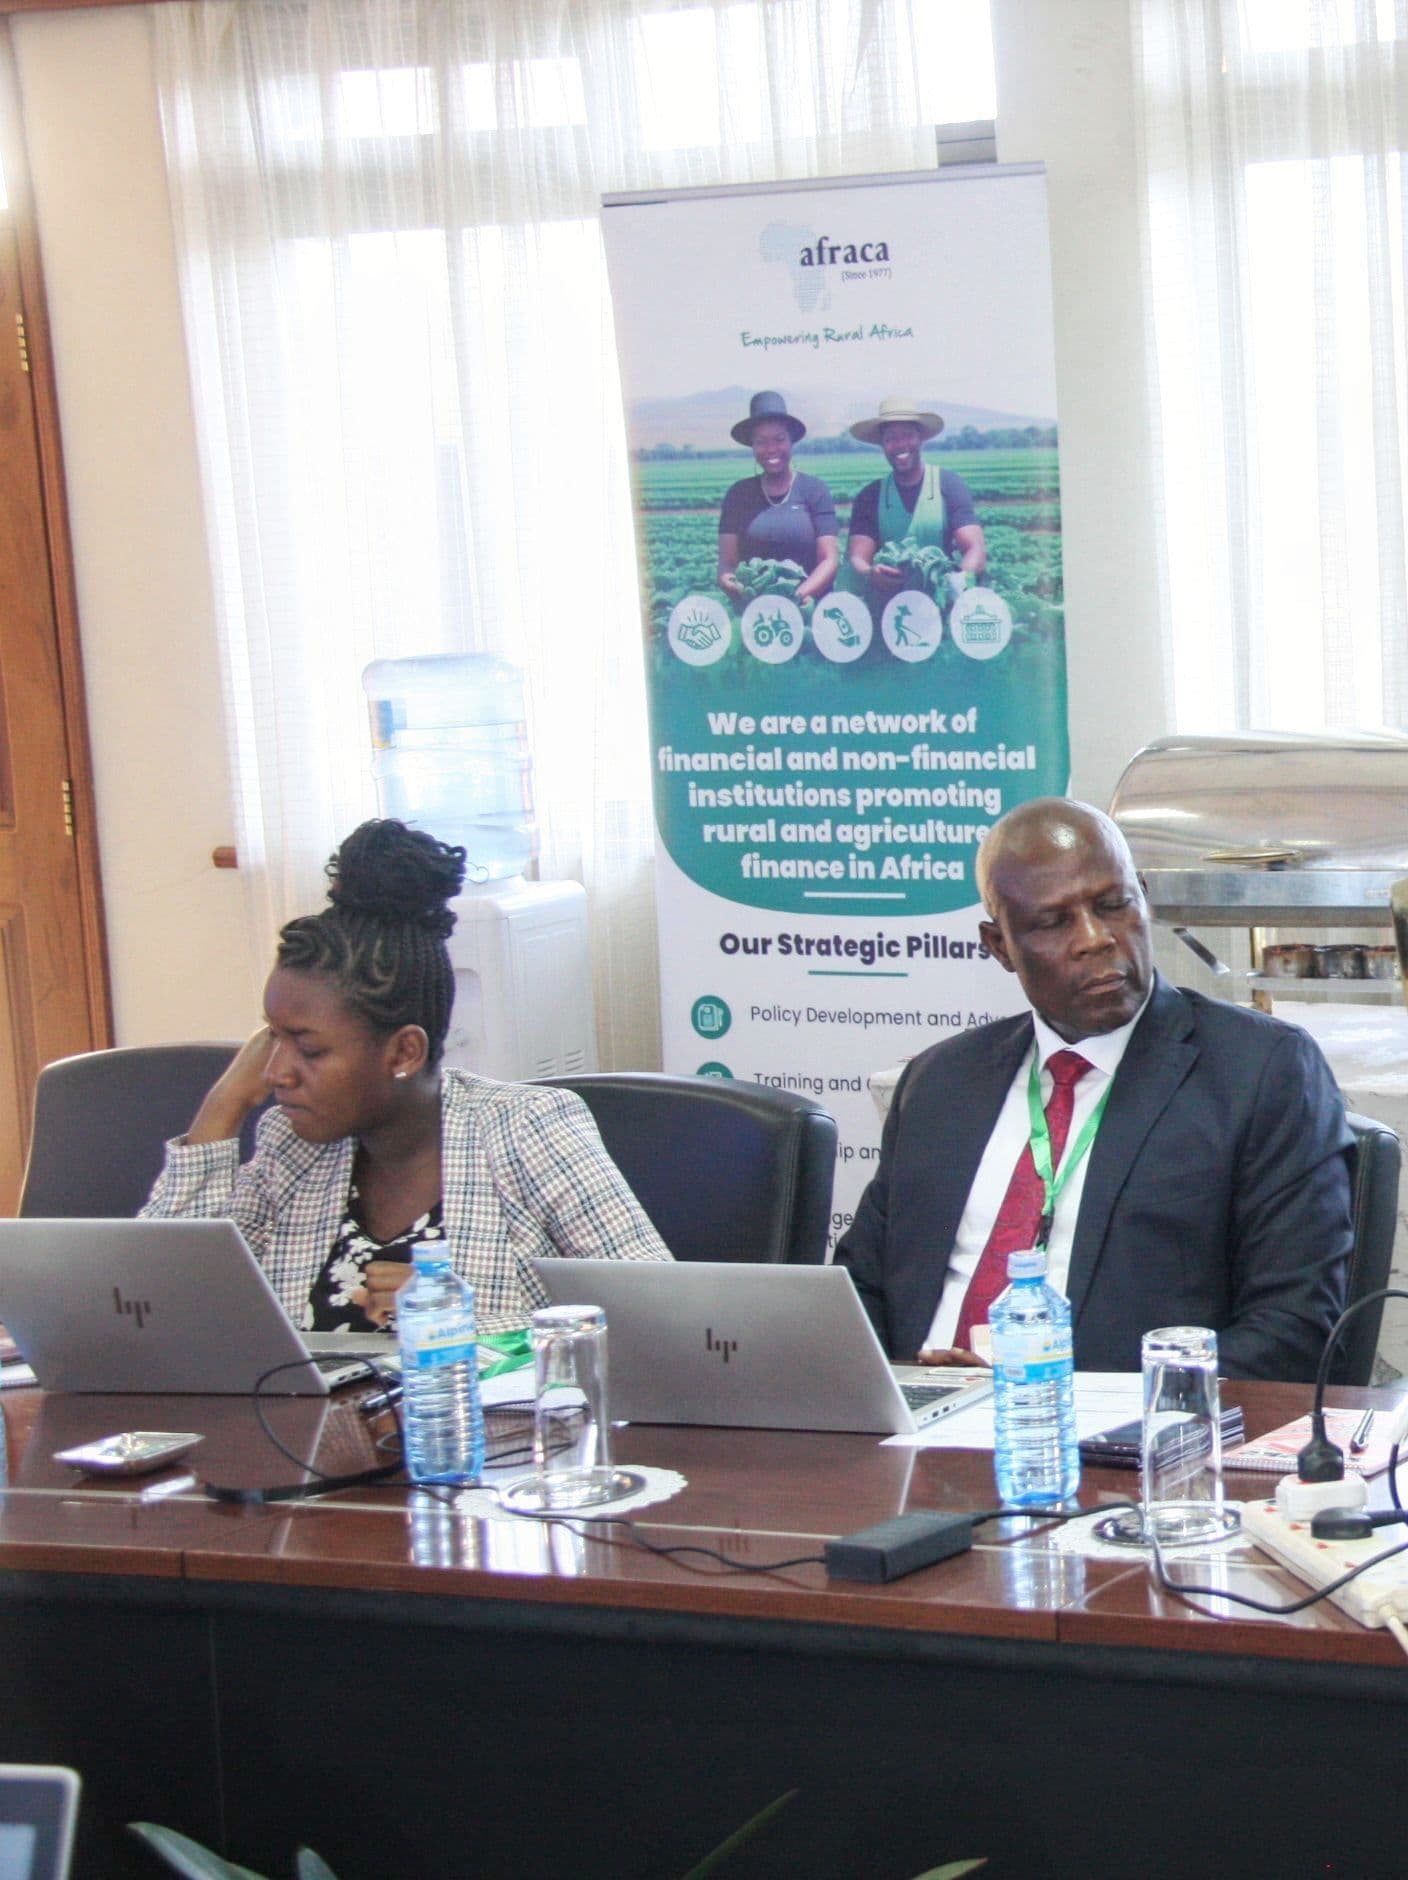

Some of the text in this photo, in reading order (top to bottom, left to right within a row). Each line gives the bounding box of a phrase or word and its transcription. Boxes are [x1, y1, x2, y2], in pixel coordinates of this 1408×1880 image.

[800, 236, 890, 267] afraca
[742, 322, 915, 351] Empowering Rural Africa
[708, 707, 977, 735] We are a network of
[658, 743, 1036, 772] financial and non-financial
[688, 780, 1002, 815] institutions promoting
[703, 818, 776, 843] rural
[780, 818, 832, 843] and
[740, 852, 965, 881] finance in Africa
[719, 932, 991, 965] Our Strategic Pillars
[750, 1005, 801, 1027] Policy
[806, 1007, 921, 1030] Development
[927, 1010, 962, 1027] and
[753, 1072, 824, 1095] Training
[830, 1074, 862, 1092] and
[112, 1286, 151, 1329] hp
[705, 1327, 738, 1364] hp
